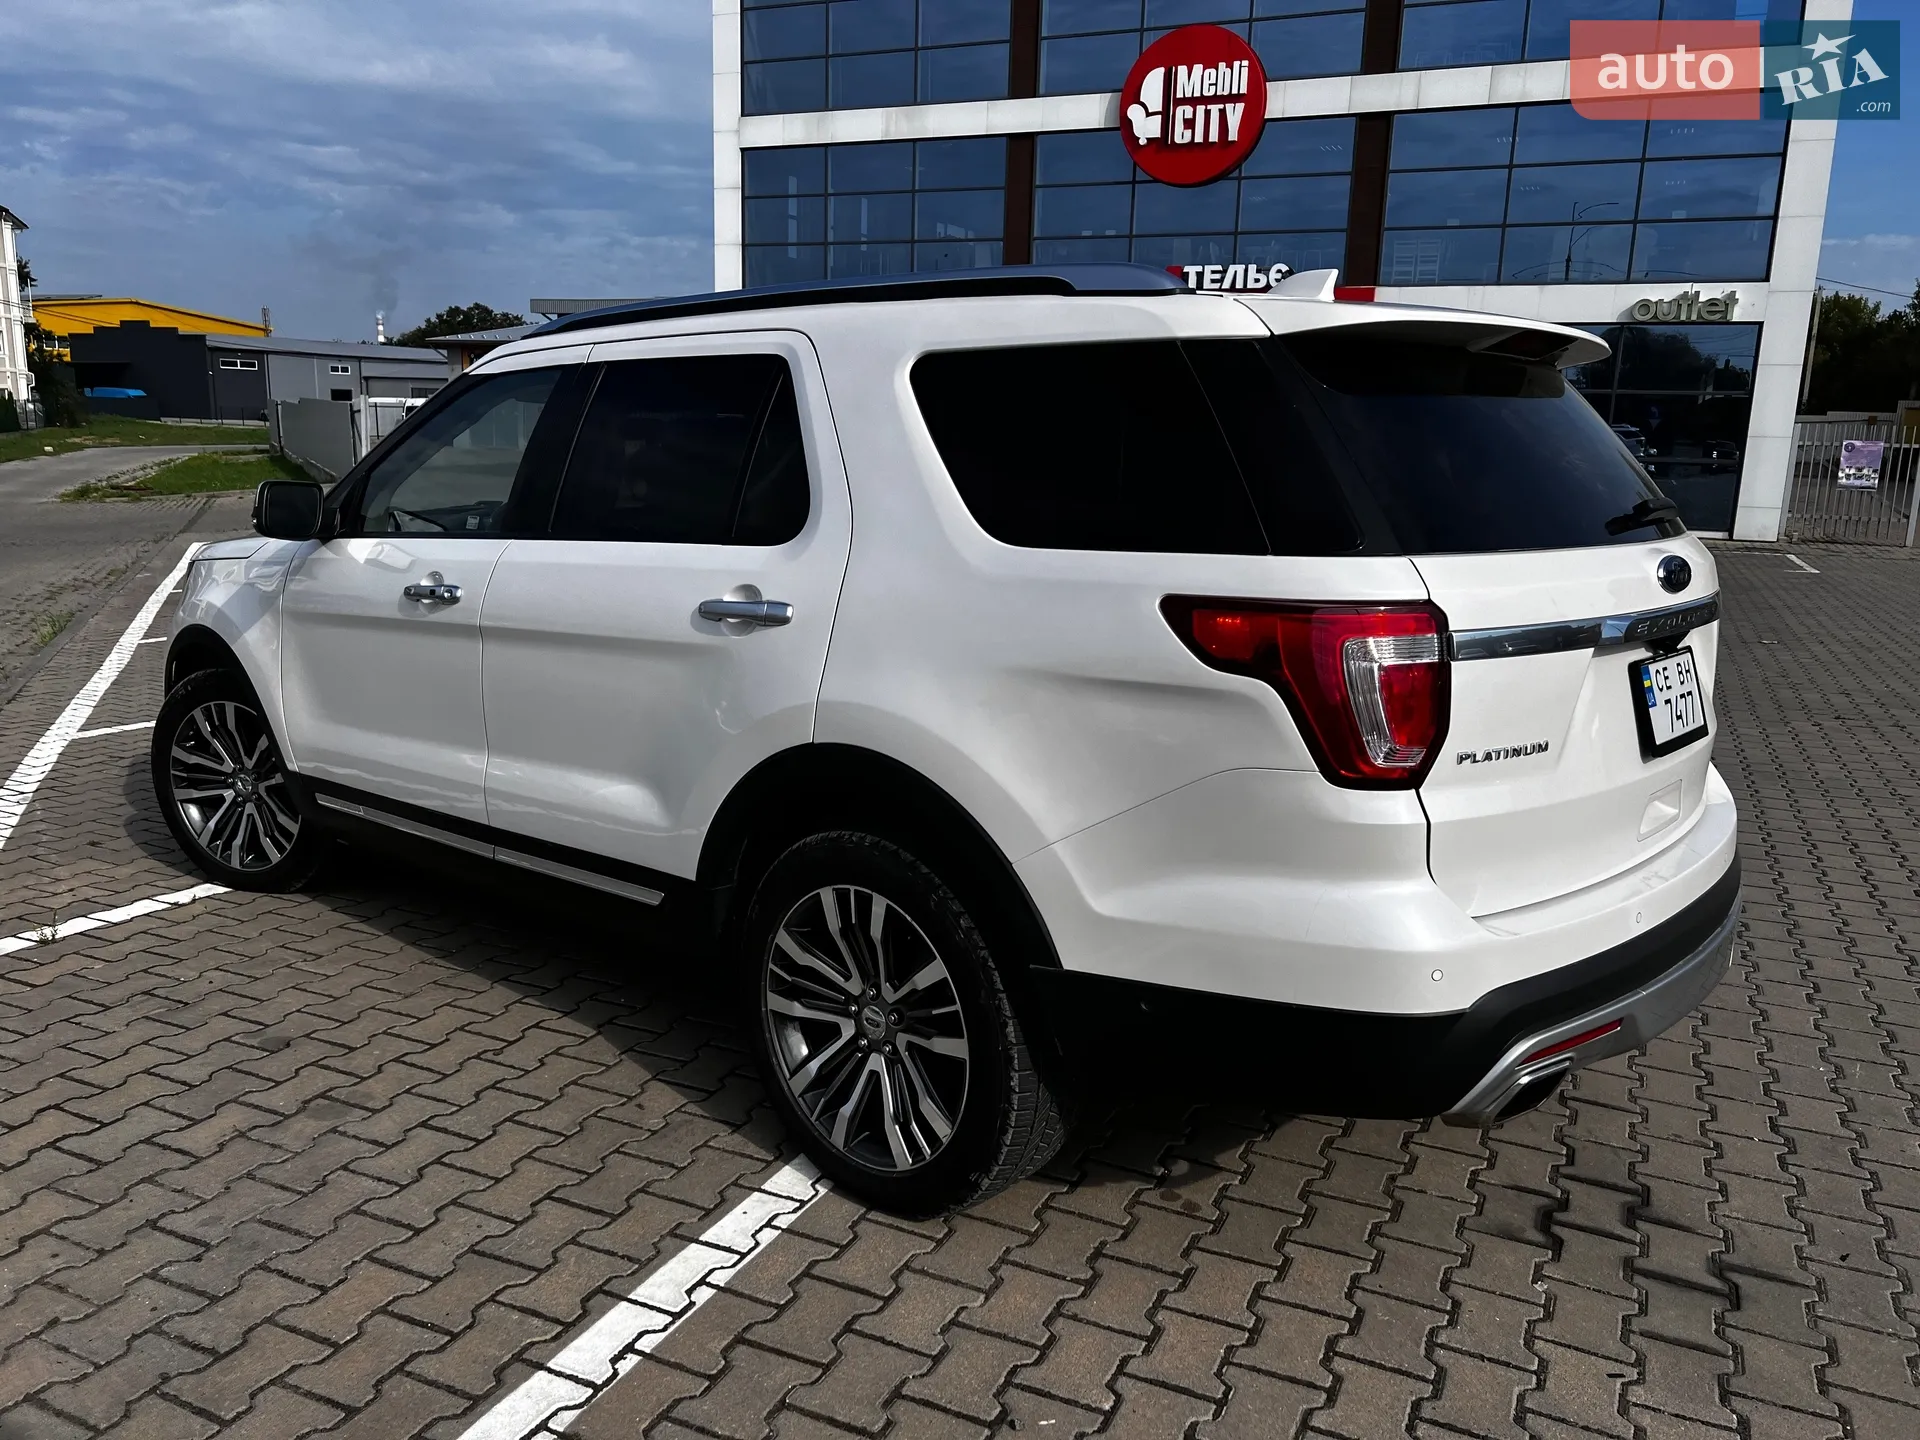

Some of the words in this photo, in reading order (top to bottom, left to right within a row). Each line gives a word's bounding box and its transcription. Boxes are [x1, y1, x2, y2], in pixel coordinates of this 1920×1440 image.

[1176, 60, 1249, 98] Mebli
[1174, 103, 1245, 144] CITY
[1632, 290, 1739, 321] outlet
[1655, 666, 1672, 692] CE
[1676, 659, 1692, 685] BH
[1664, 690, 1695, 733] 7477
[1456, 740, 1549, 765] PLATINUM
